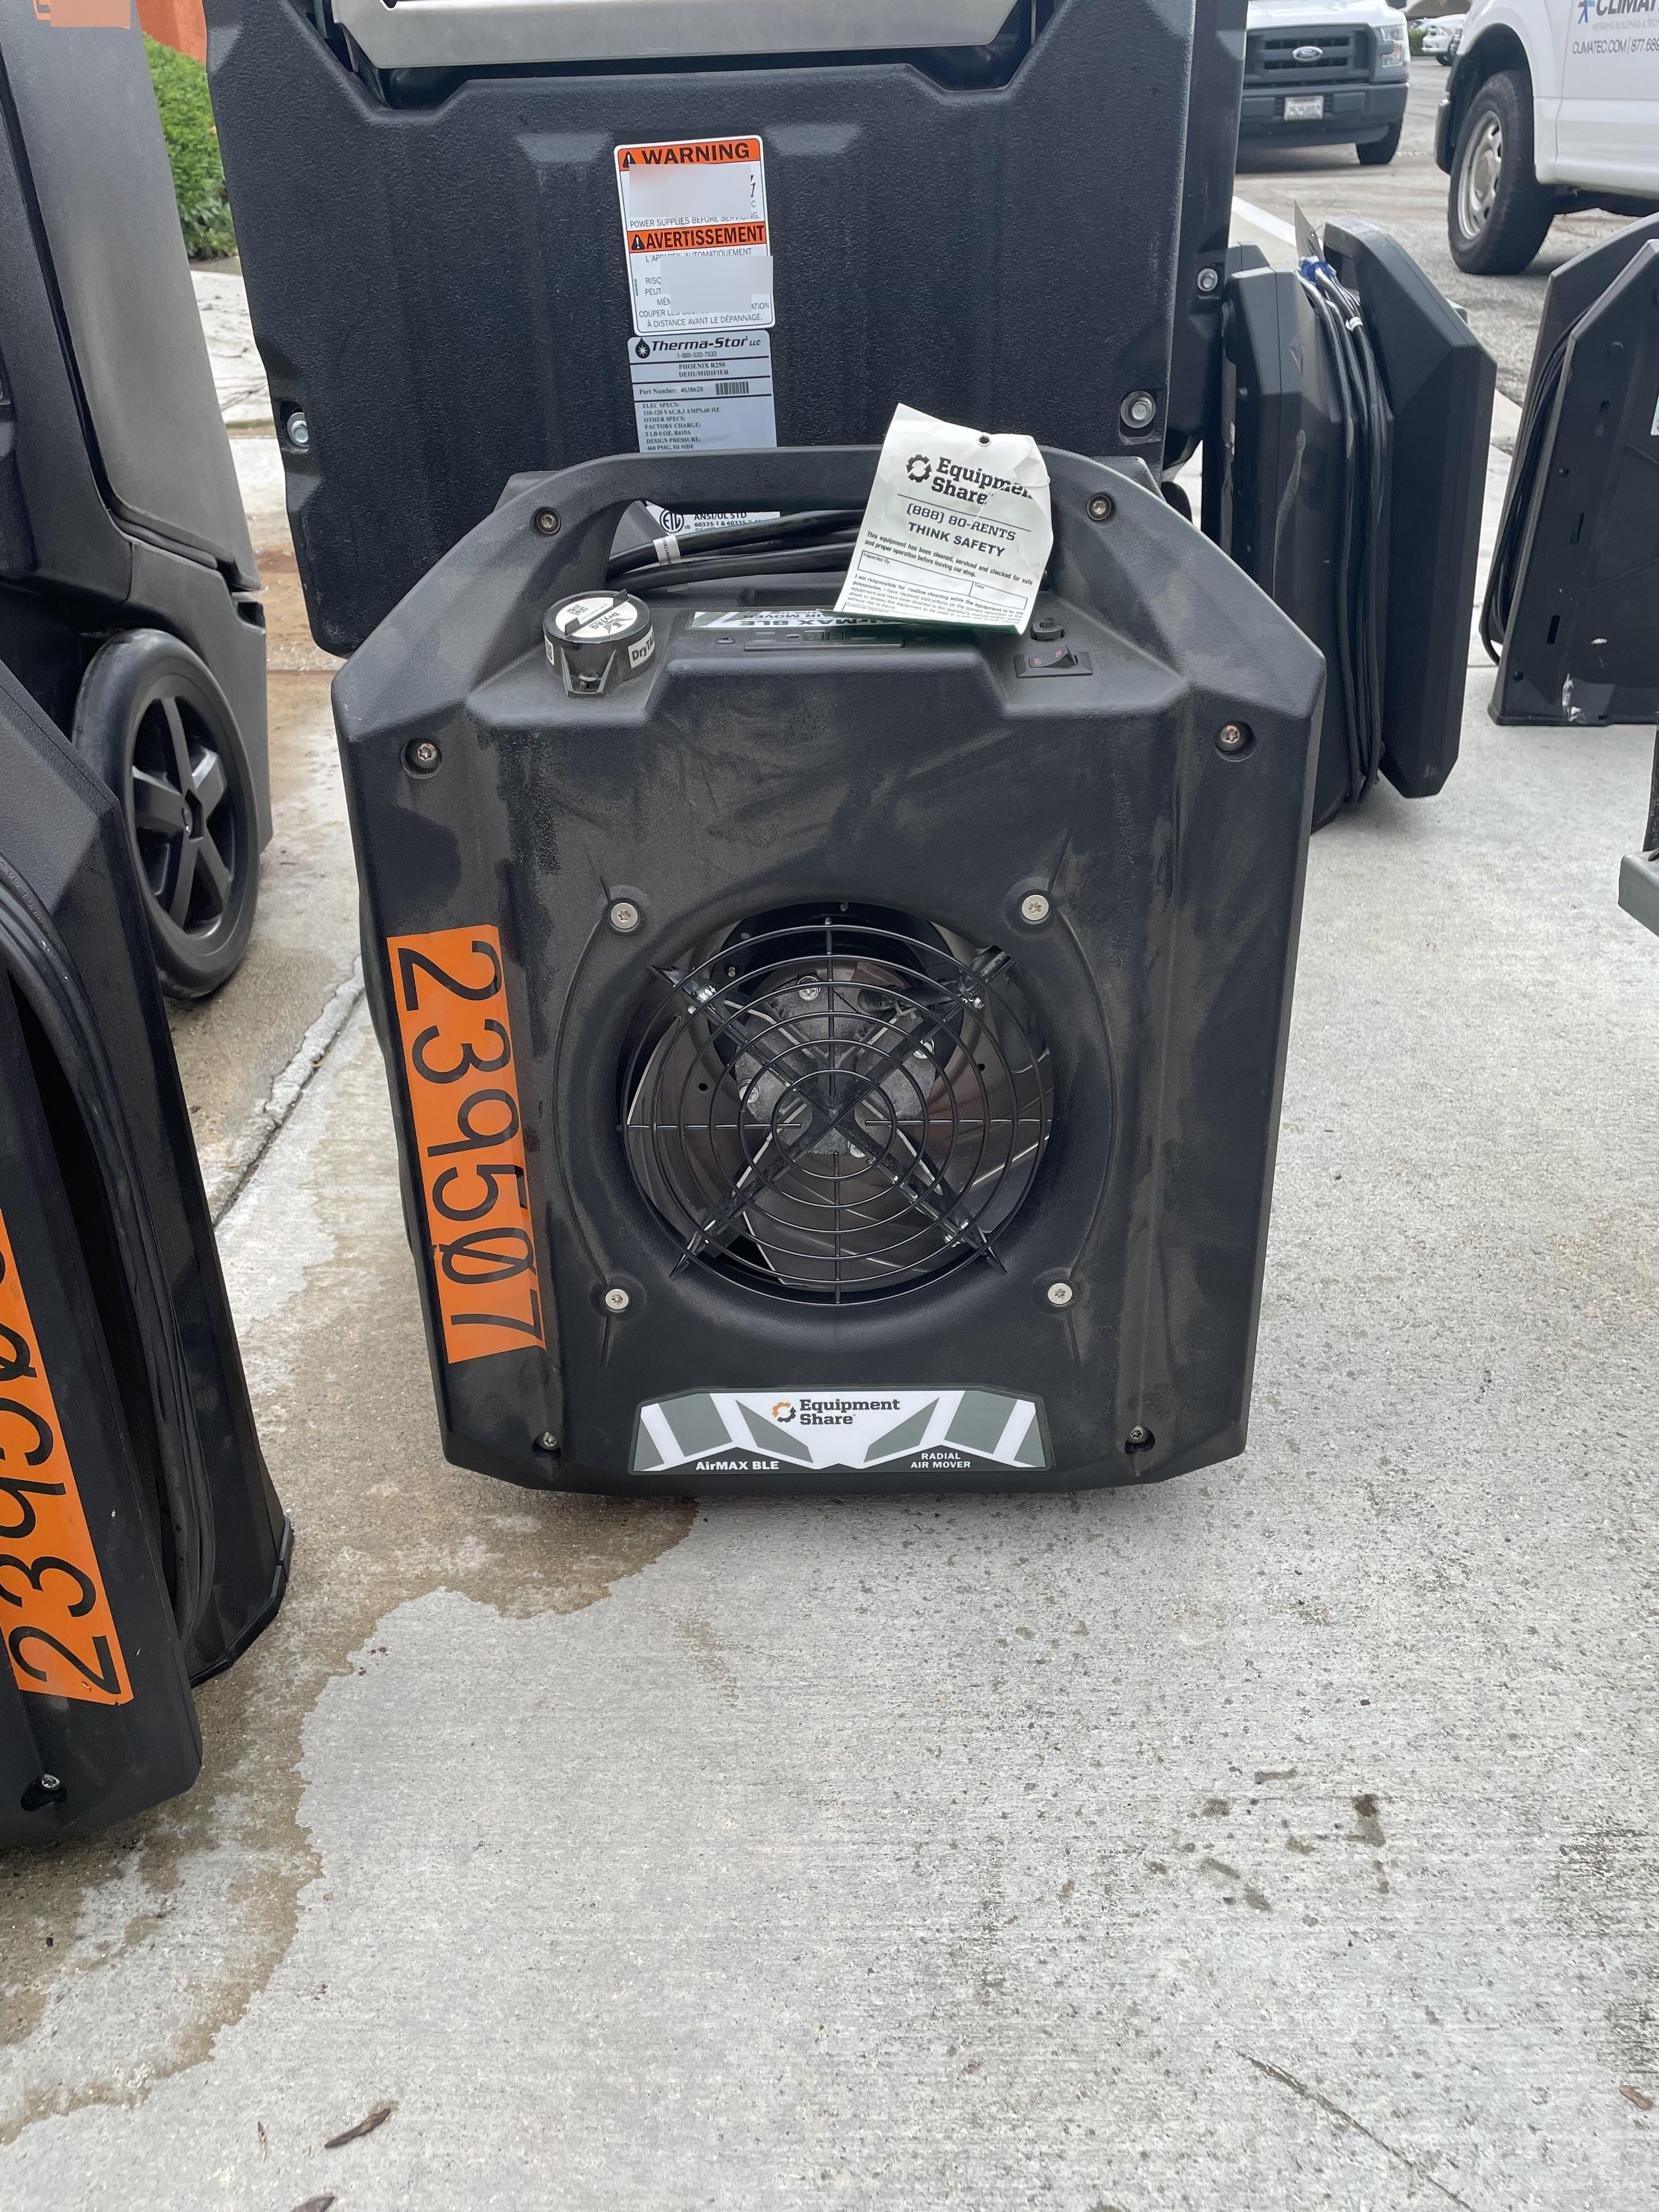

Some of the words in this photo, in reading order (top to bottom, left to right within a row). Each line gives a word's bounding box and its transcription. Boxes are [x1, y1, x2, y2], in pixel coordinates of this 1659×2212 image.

[1596, 0, 1659, 16] CLIMAT
[1572, 40, 1627, 54] CLIMATEC.COM
[641, 142, 749, 164] WARNING
[630, 219, 654, 228] POWER
[658, 217, 690, 226] SUPPLIES
[646, 225, 764, 249] AVERTISSEMENT
[639, 309, 665, 318] COUPER
[653, 318, 686, 327] DISTANCE
[688, 317, 708, 325] AVANT
[652, 336, 747, 351] Therma-Stor
[679, 369, 729, 378] DEHUMIDIFIER
[932, 476, 988, 505] Share
[906, 503, 945, 523] (888)
[948, 515, 1017, 541] 80-RENTS
[909, 522, 951, 542] THINK
[953, 535, 1006, 557] SAFETY
[863, 552, 884, 562] Inspected
[867, 531, 878, 539] This
[879, 535, 906, 548] equipment
[908, 543, 917, 551] has
[919, 546, 932, 555] been
[955, 558, 978, 569] serviced
[990, 568, 1012, 579] checked
[874, 543, 893, 551] proper
[893, 548, 916, 560] operation
[917, 554, 934, 565] before
[934, 560, 952, 571] leaving
[963, 569, 976, 578] shop.
[853, 580, 882, 591] possession.
[908, 586, 926, 595] routine
[927, 591, 949, 600] cleaning
[974, 602, 1002, 612] equipment
[397, 940, 545, 1344] 239507
[799, 1398, 900, 1414] Equipment
[799, 1413, 854, 1425] Share
[921, 1452, 961, 1460] RADIAL
[695, 1459, 749, 1471] AirMAX
[752, 1459, 780, 1470] BLE
[910, 1460, 928, 1469] AIR
[930, 1460, 972, 1469] MOVER
